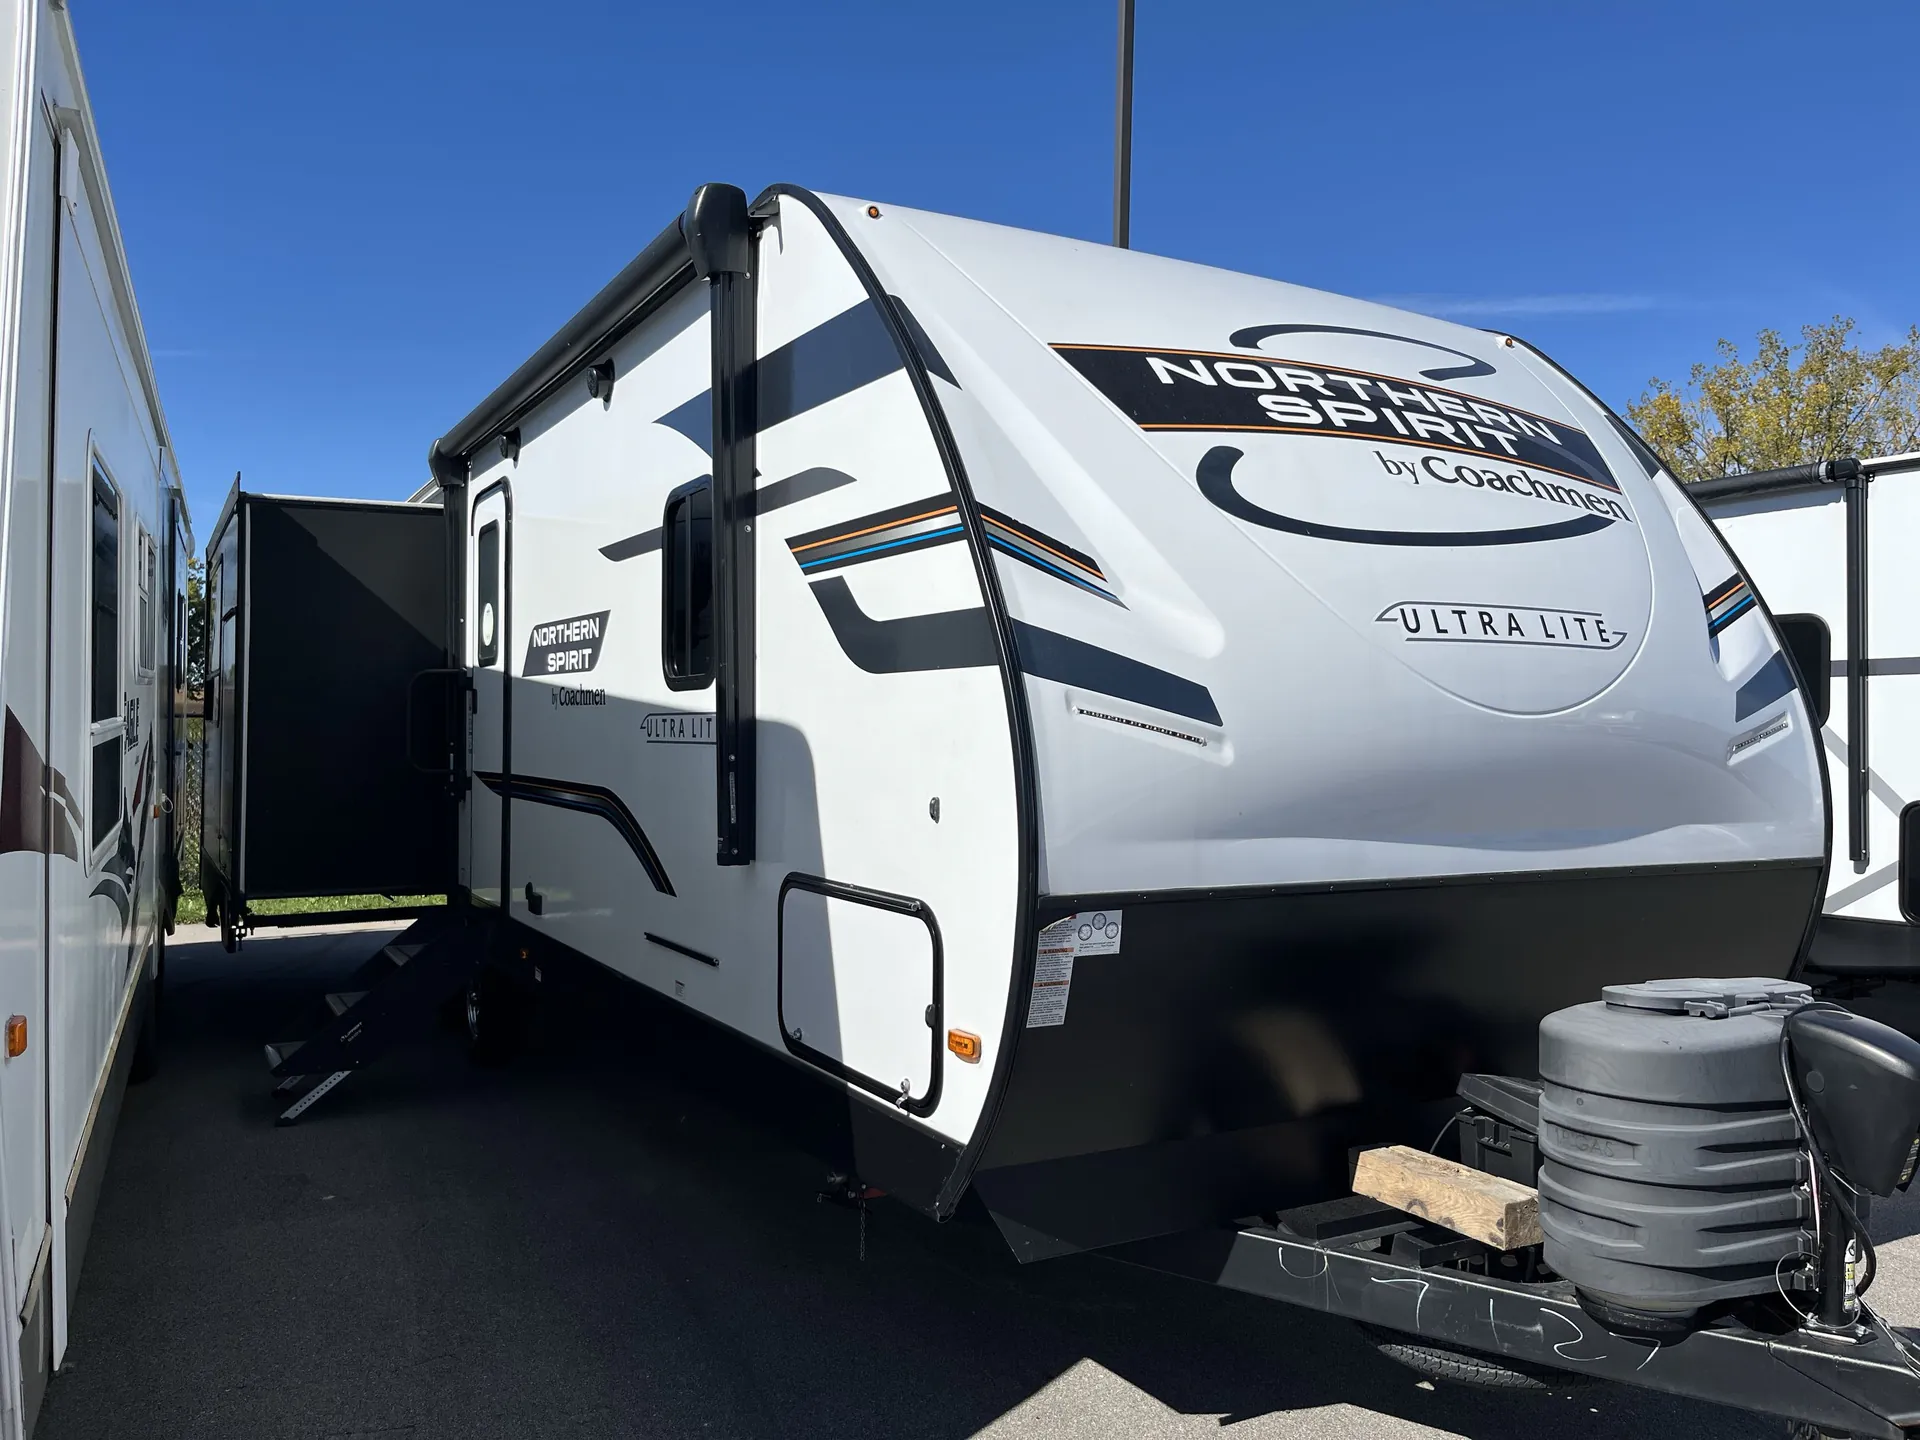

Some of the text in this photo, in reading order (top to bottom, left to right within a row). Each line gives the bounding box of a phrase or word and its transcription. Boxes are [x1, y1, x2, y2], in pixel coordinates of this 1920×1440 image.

[1144, 355, 1563, 446] NORTHERN
[1264, 394, 1519, 457] SPIRIT
[1373, 450, 1634, 523] by Coachmen
[533, 617, 600, 648] NORTHERN
[1398, 608, 1612, 644] ULTRA LITE
[547, 648, 593, 672] SPIRIT
[551, 684, 606, 710] by Coachmen
[646, 717, 713, 738] ULTRA LIT
